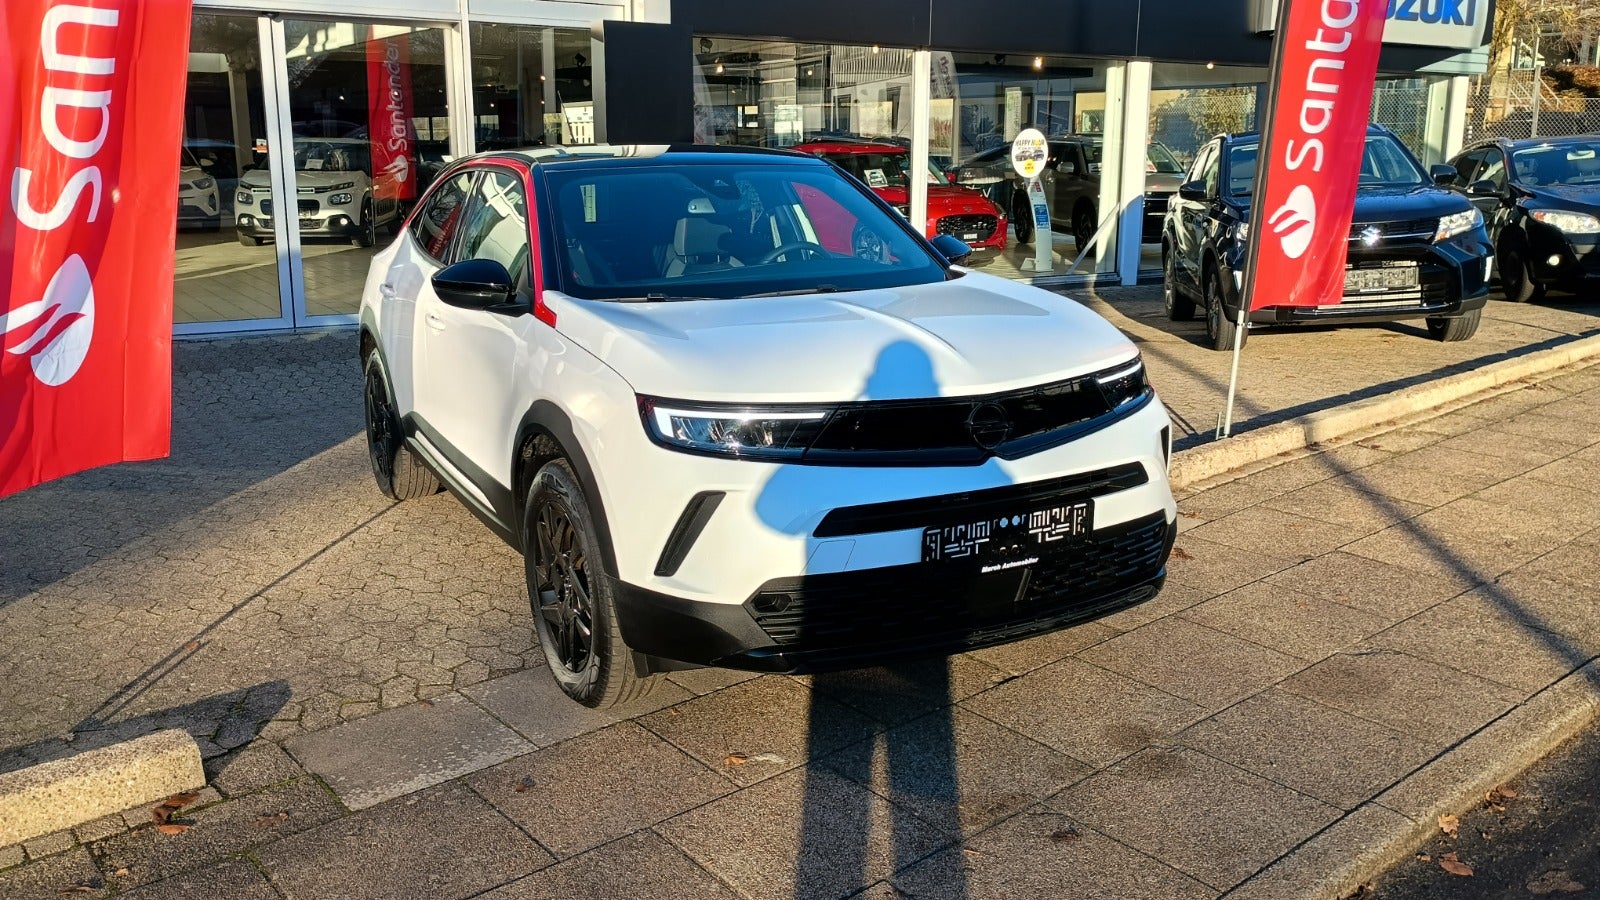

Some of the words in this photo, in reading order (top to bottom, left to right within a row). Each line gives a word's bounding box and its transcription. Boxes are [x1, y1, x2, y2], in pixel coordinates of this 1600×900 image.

[11, 4, 119, 230] San
[385, 42, 408, 151] Santander
[1285, 0, 1360, 172] Santa
